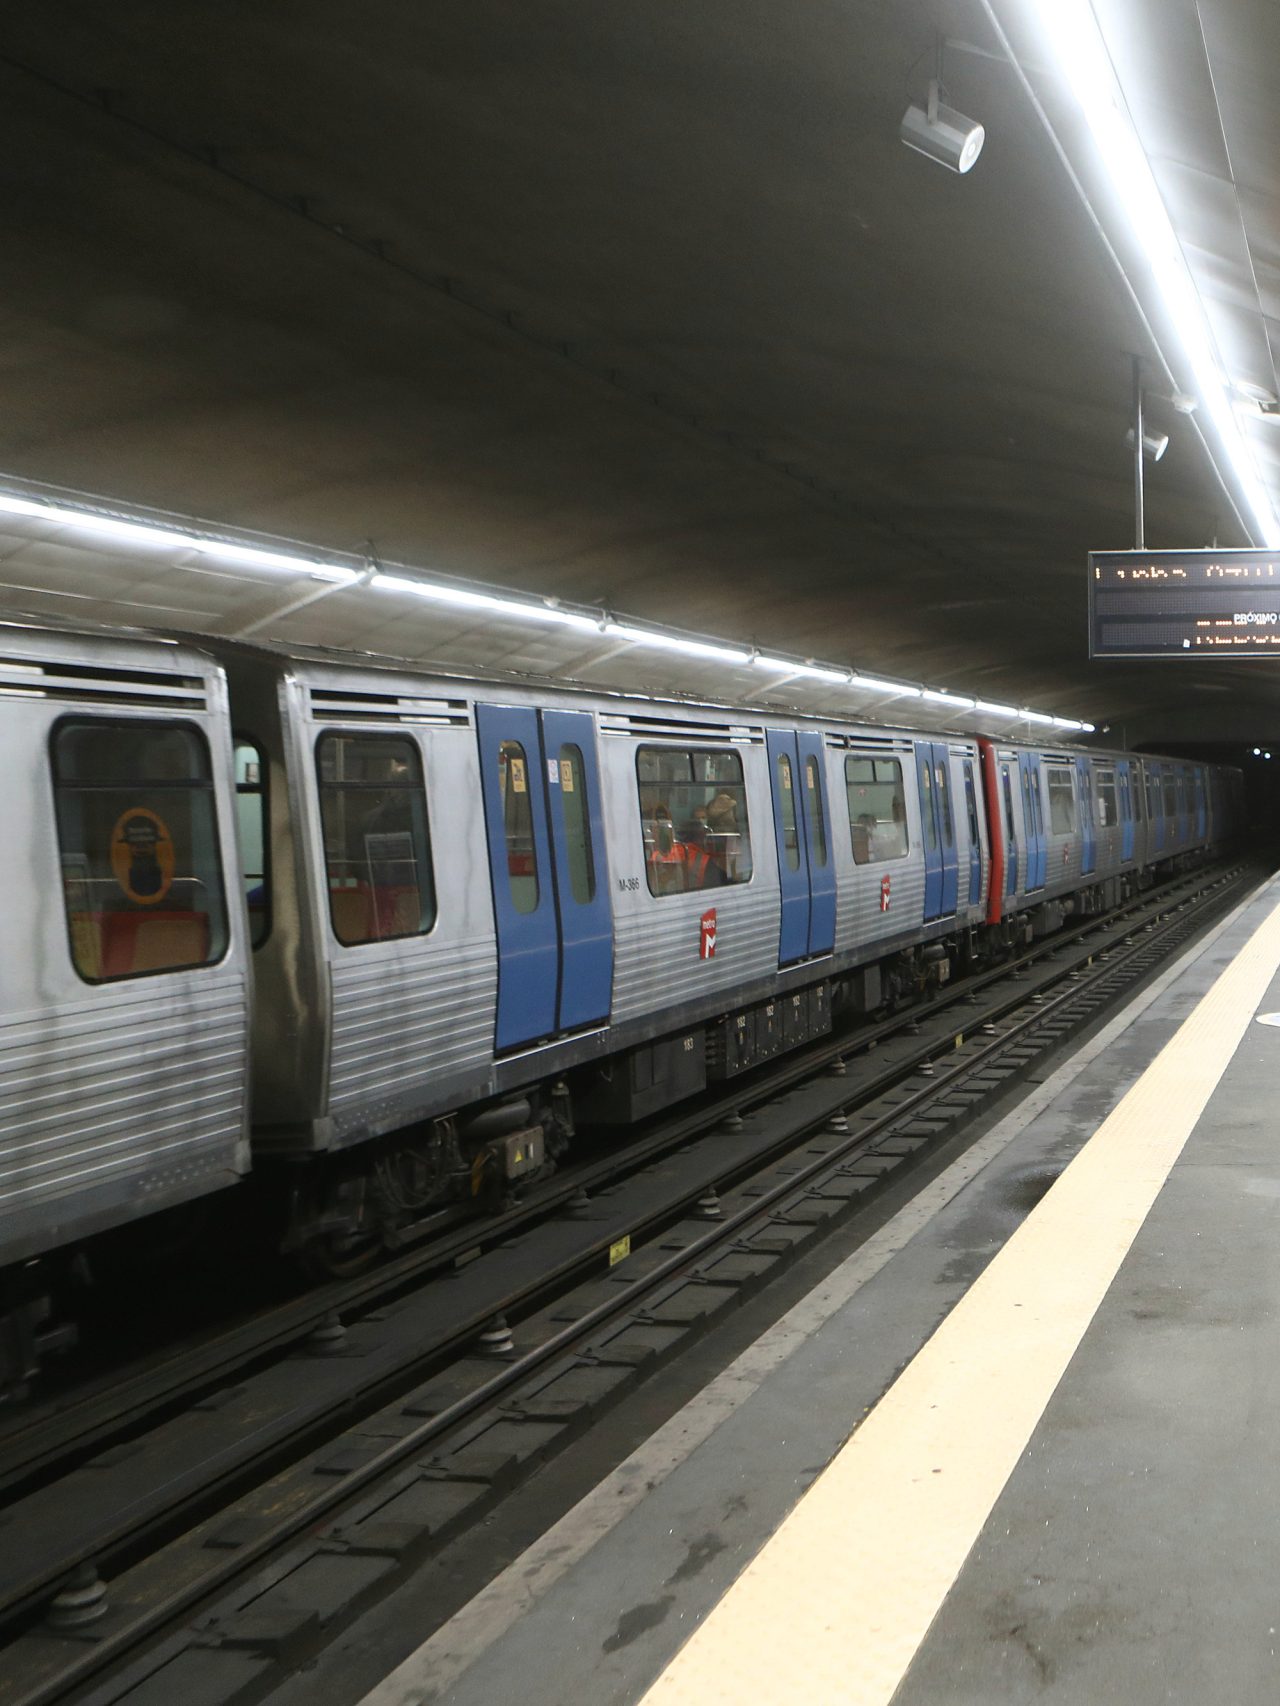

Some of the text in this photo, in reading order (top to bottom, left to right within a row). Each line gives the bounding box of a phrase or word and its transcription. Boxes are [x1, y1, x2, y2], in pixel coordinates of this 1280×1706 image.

[1233, 611, 1278, 623] PRÓXIMO
[618, 877, 640, 892] M-366
[765, 1004, 775, 1017] 182
[736, 1015, 747, 1029] 182
[682, 1036, 695, 1052] 183
